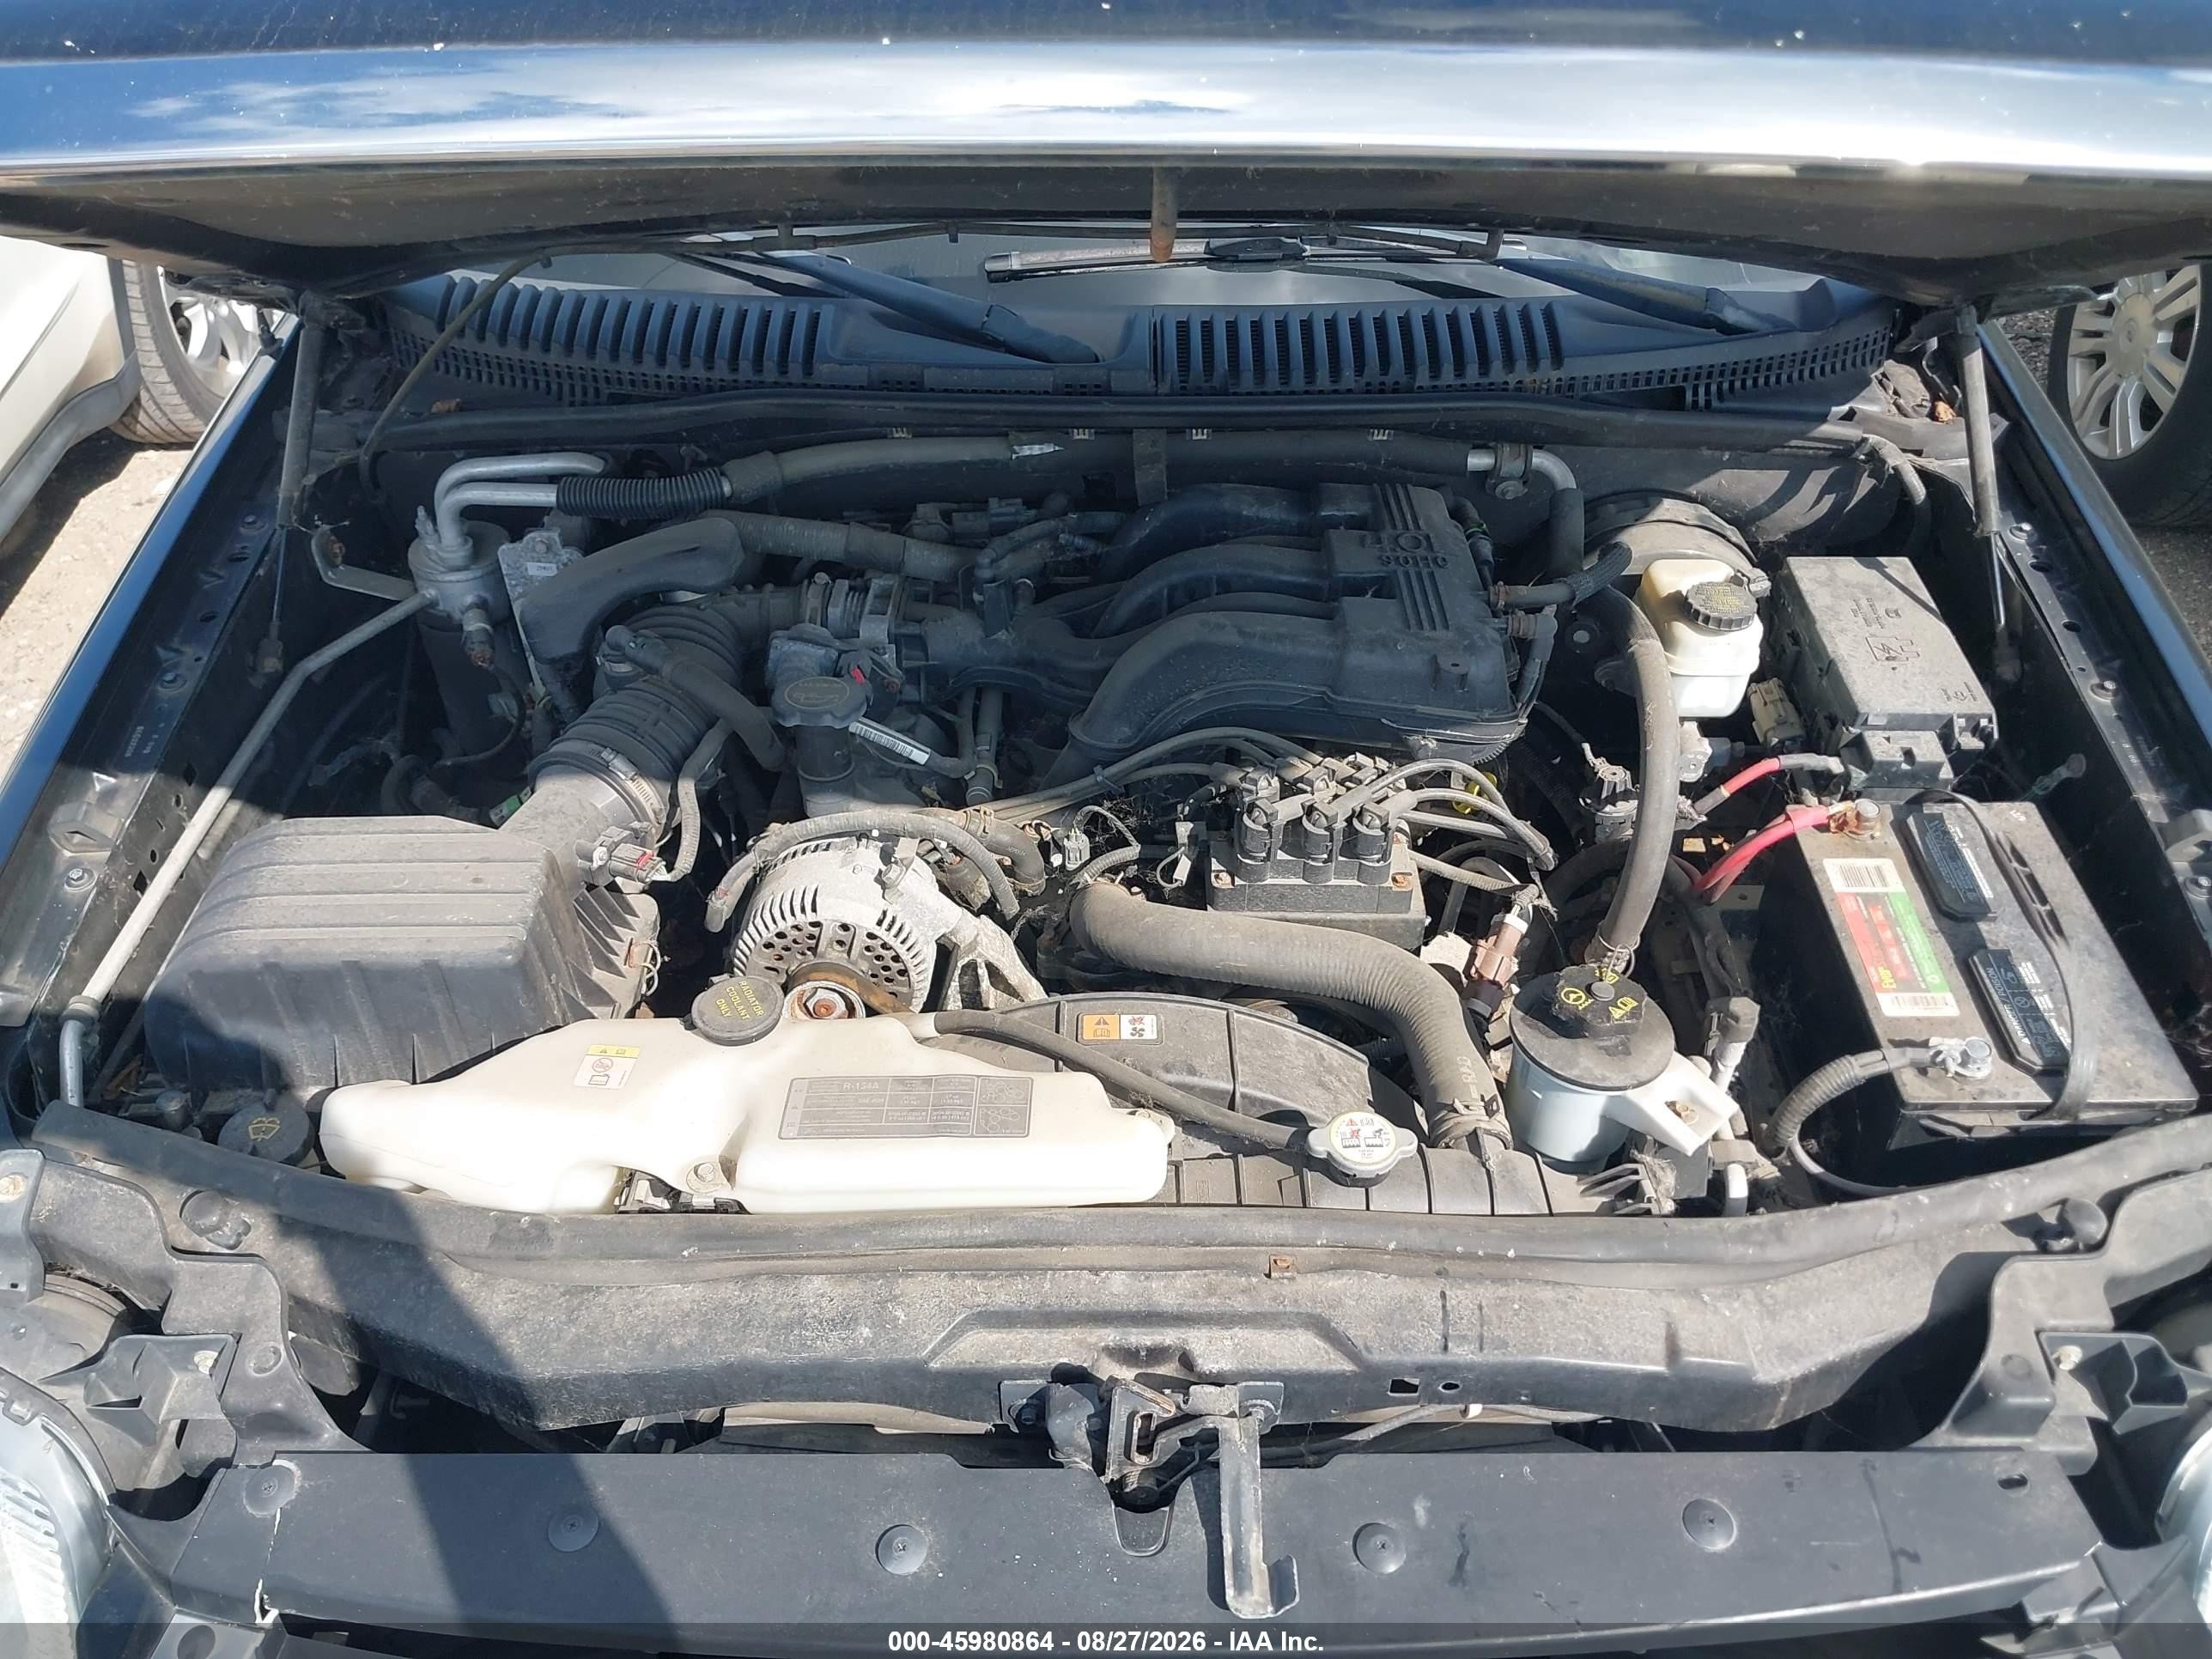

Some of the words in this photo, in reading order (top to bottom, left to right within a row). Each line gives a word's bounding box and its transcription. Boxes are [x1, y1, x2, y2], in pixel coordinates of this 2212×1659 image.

[1379, 555, 1450, 569] SOHC
[1985, 968, 2008, 996] POISON
[715, 998, 732, 1018] ONLY
[726, 986, 750, 1020] COOLANT
[738, 980, 764, 1017] RADIATOR
